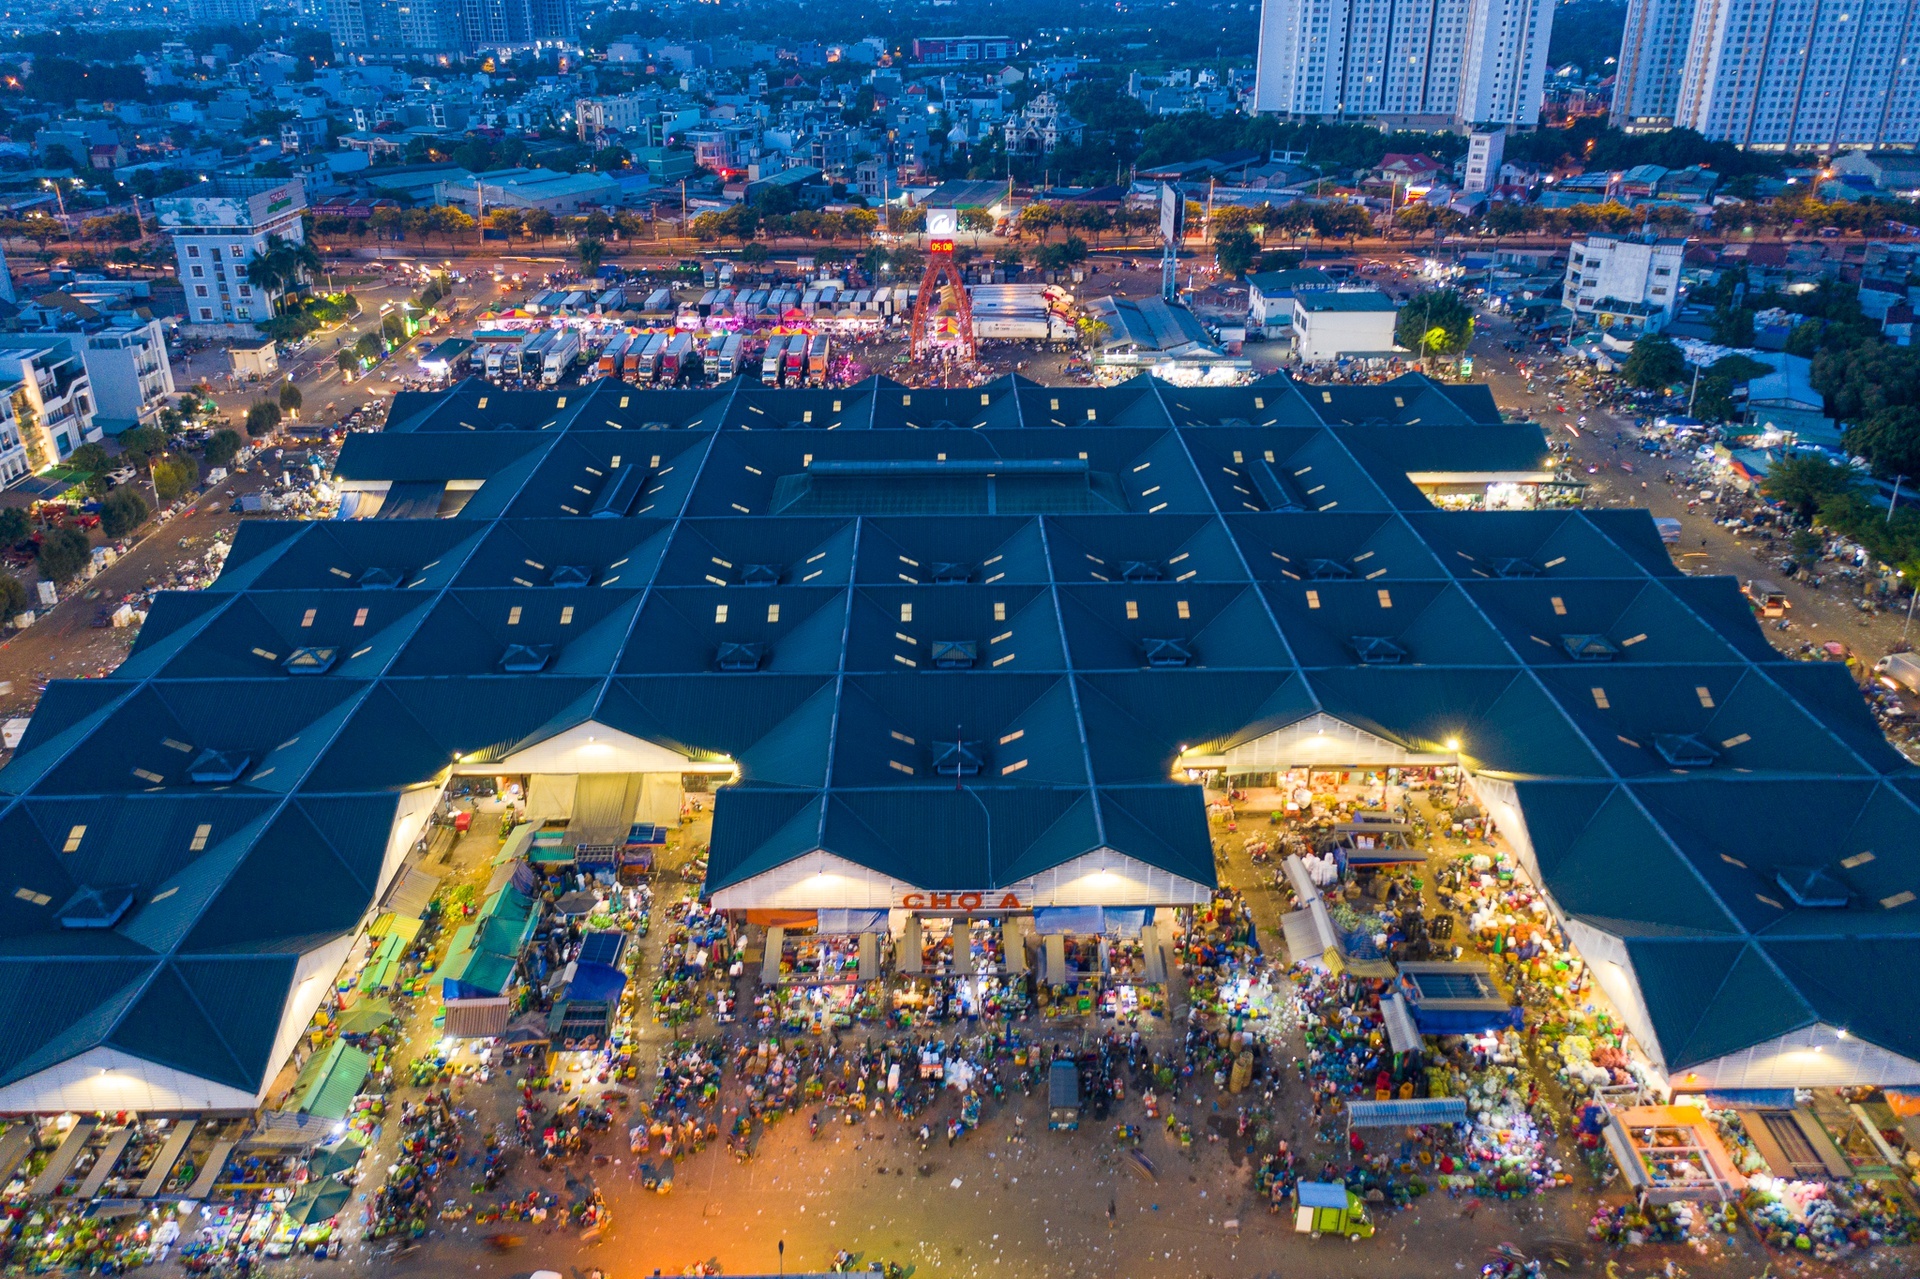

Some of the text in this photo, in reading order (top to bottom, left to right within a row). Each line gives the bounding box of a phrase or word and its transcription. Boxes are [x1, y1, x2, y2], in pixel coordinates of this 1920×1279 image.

[931, 242, 953, 251] 05:08
[903, 892, 1022, 913] CHỢ A
